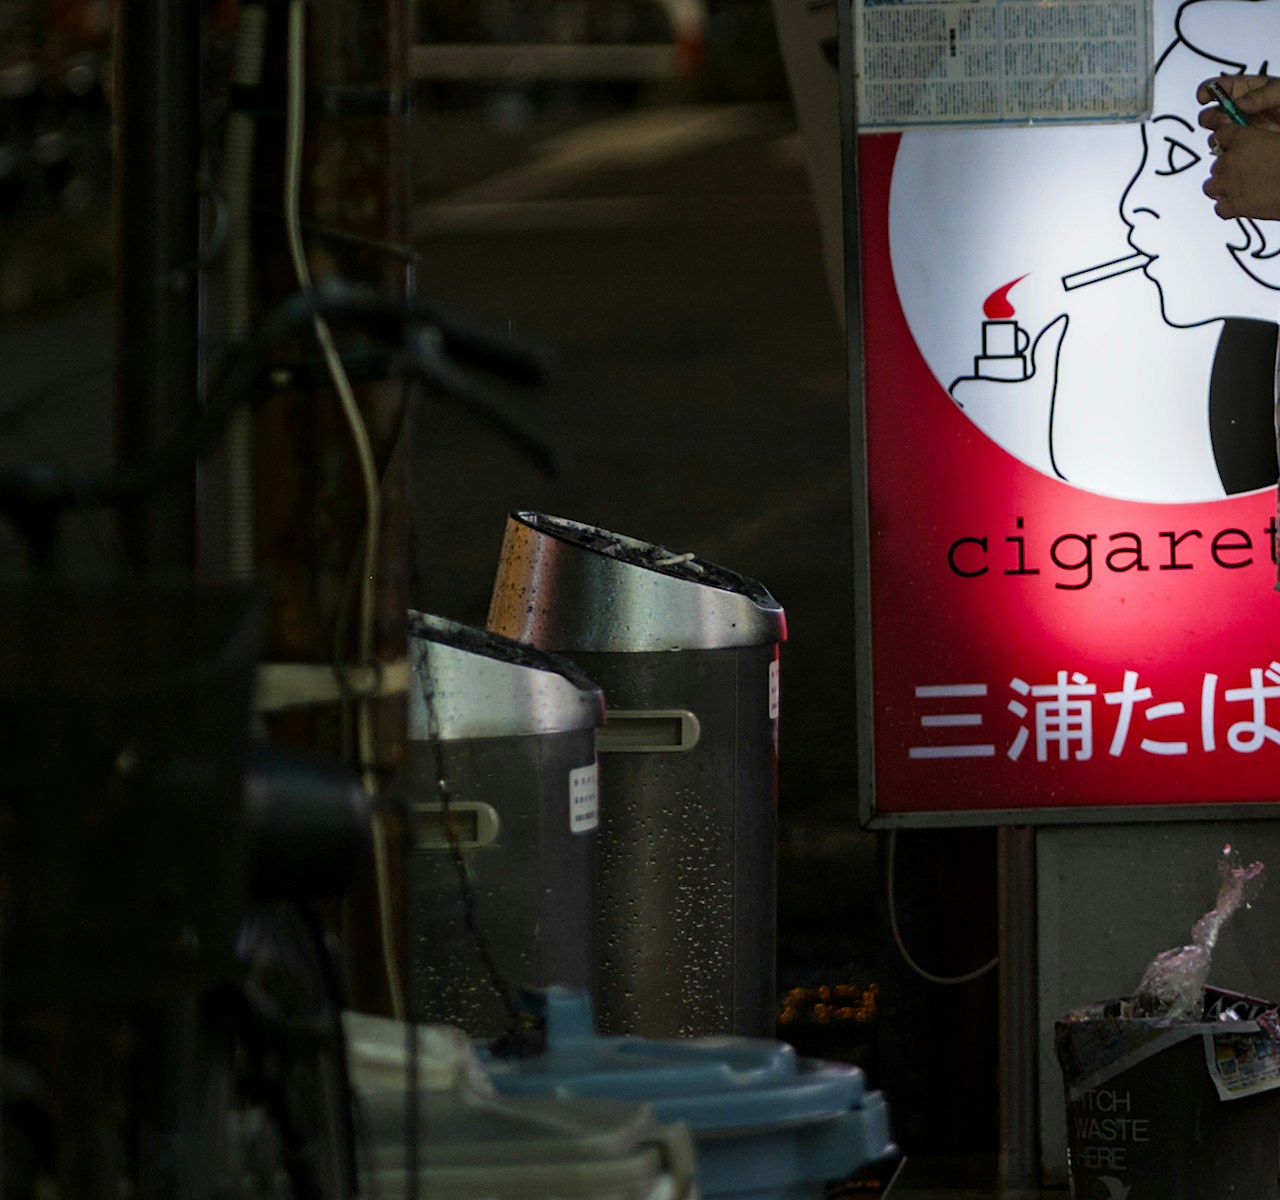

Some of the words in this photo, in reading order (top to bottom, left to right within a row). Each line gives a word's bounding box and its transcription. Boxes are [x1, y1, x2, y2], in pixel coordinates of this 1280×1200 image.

[1074, 1089, 1131, 1113] ITCH
[1074, 1118, 1150, 1143] WASTE
[1075, 1147, 1129, 1171] HERE
